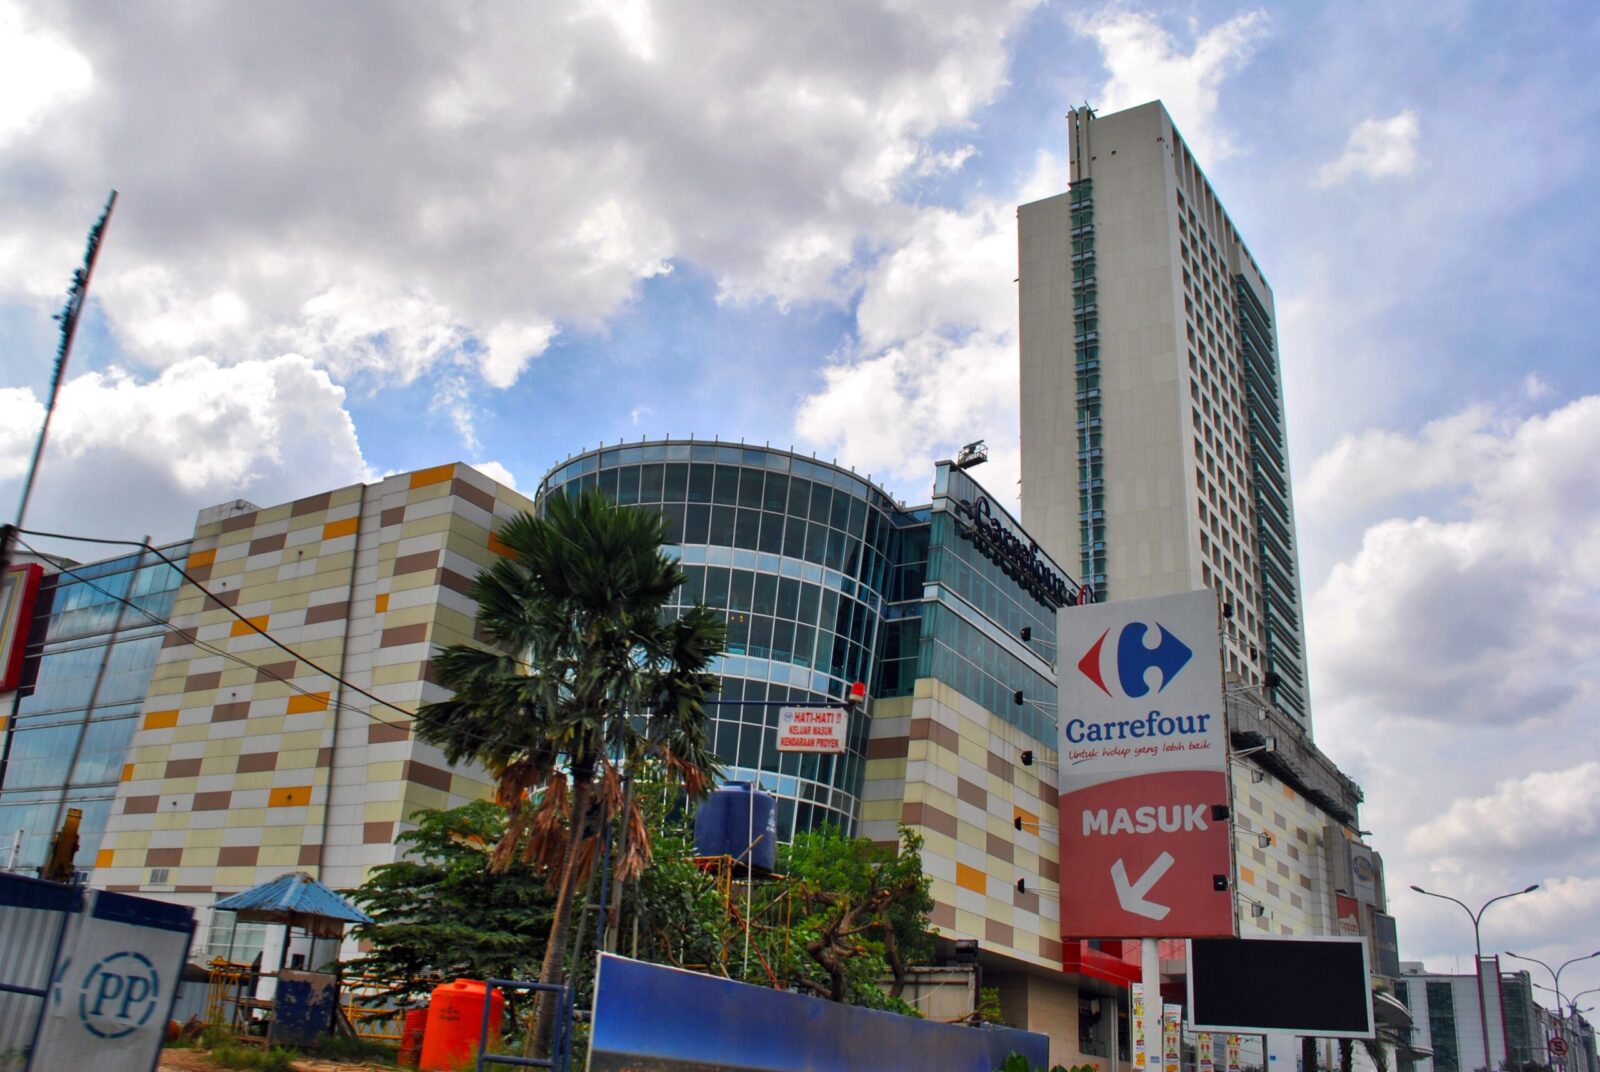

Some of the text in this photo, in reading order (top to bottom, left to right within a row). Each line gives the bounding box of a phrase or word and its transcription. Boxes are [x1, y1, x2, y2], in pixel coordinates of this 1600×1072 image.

[794, 712, 834, 724] HATI-HATI
[1065, 710, 1211, 743] Carrefour
[789, 725, 833, 736] KELUAR MASUK
[781, 737, 839, 748] KENDARAAN PROYEK
[1069, 739, 1212, 761] Untuk hidup yang lebih baik
[1082, 803, 1209, 837] MASUK
[89, 971, 150, 1019] PP
